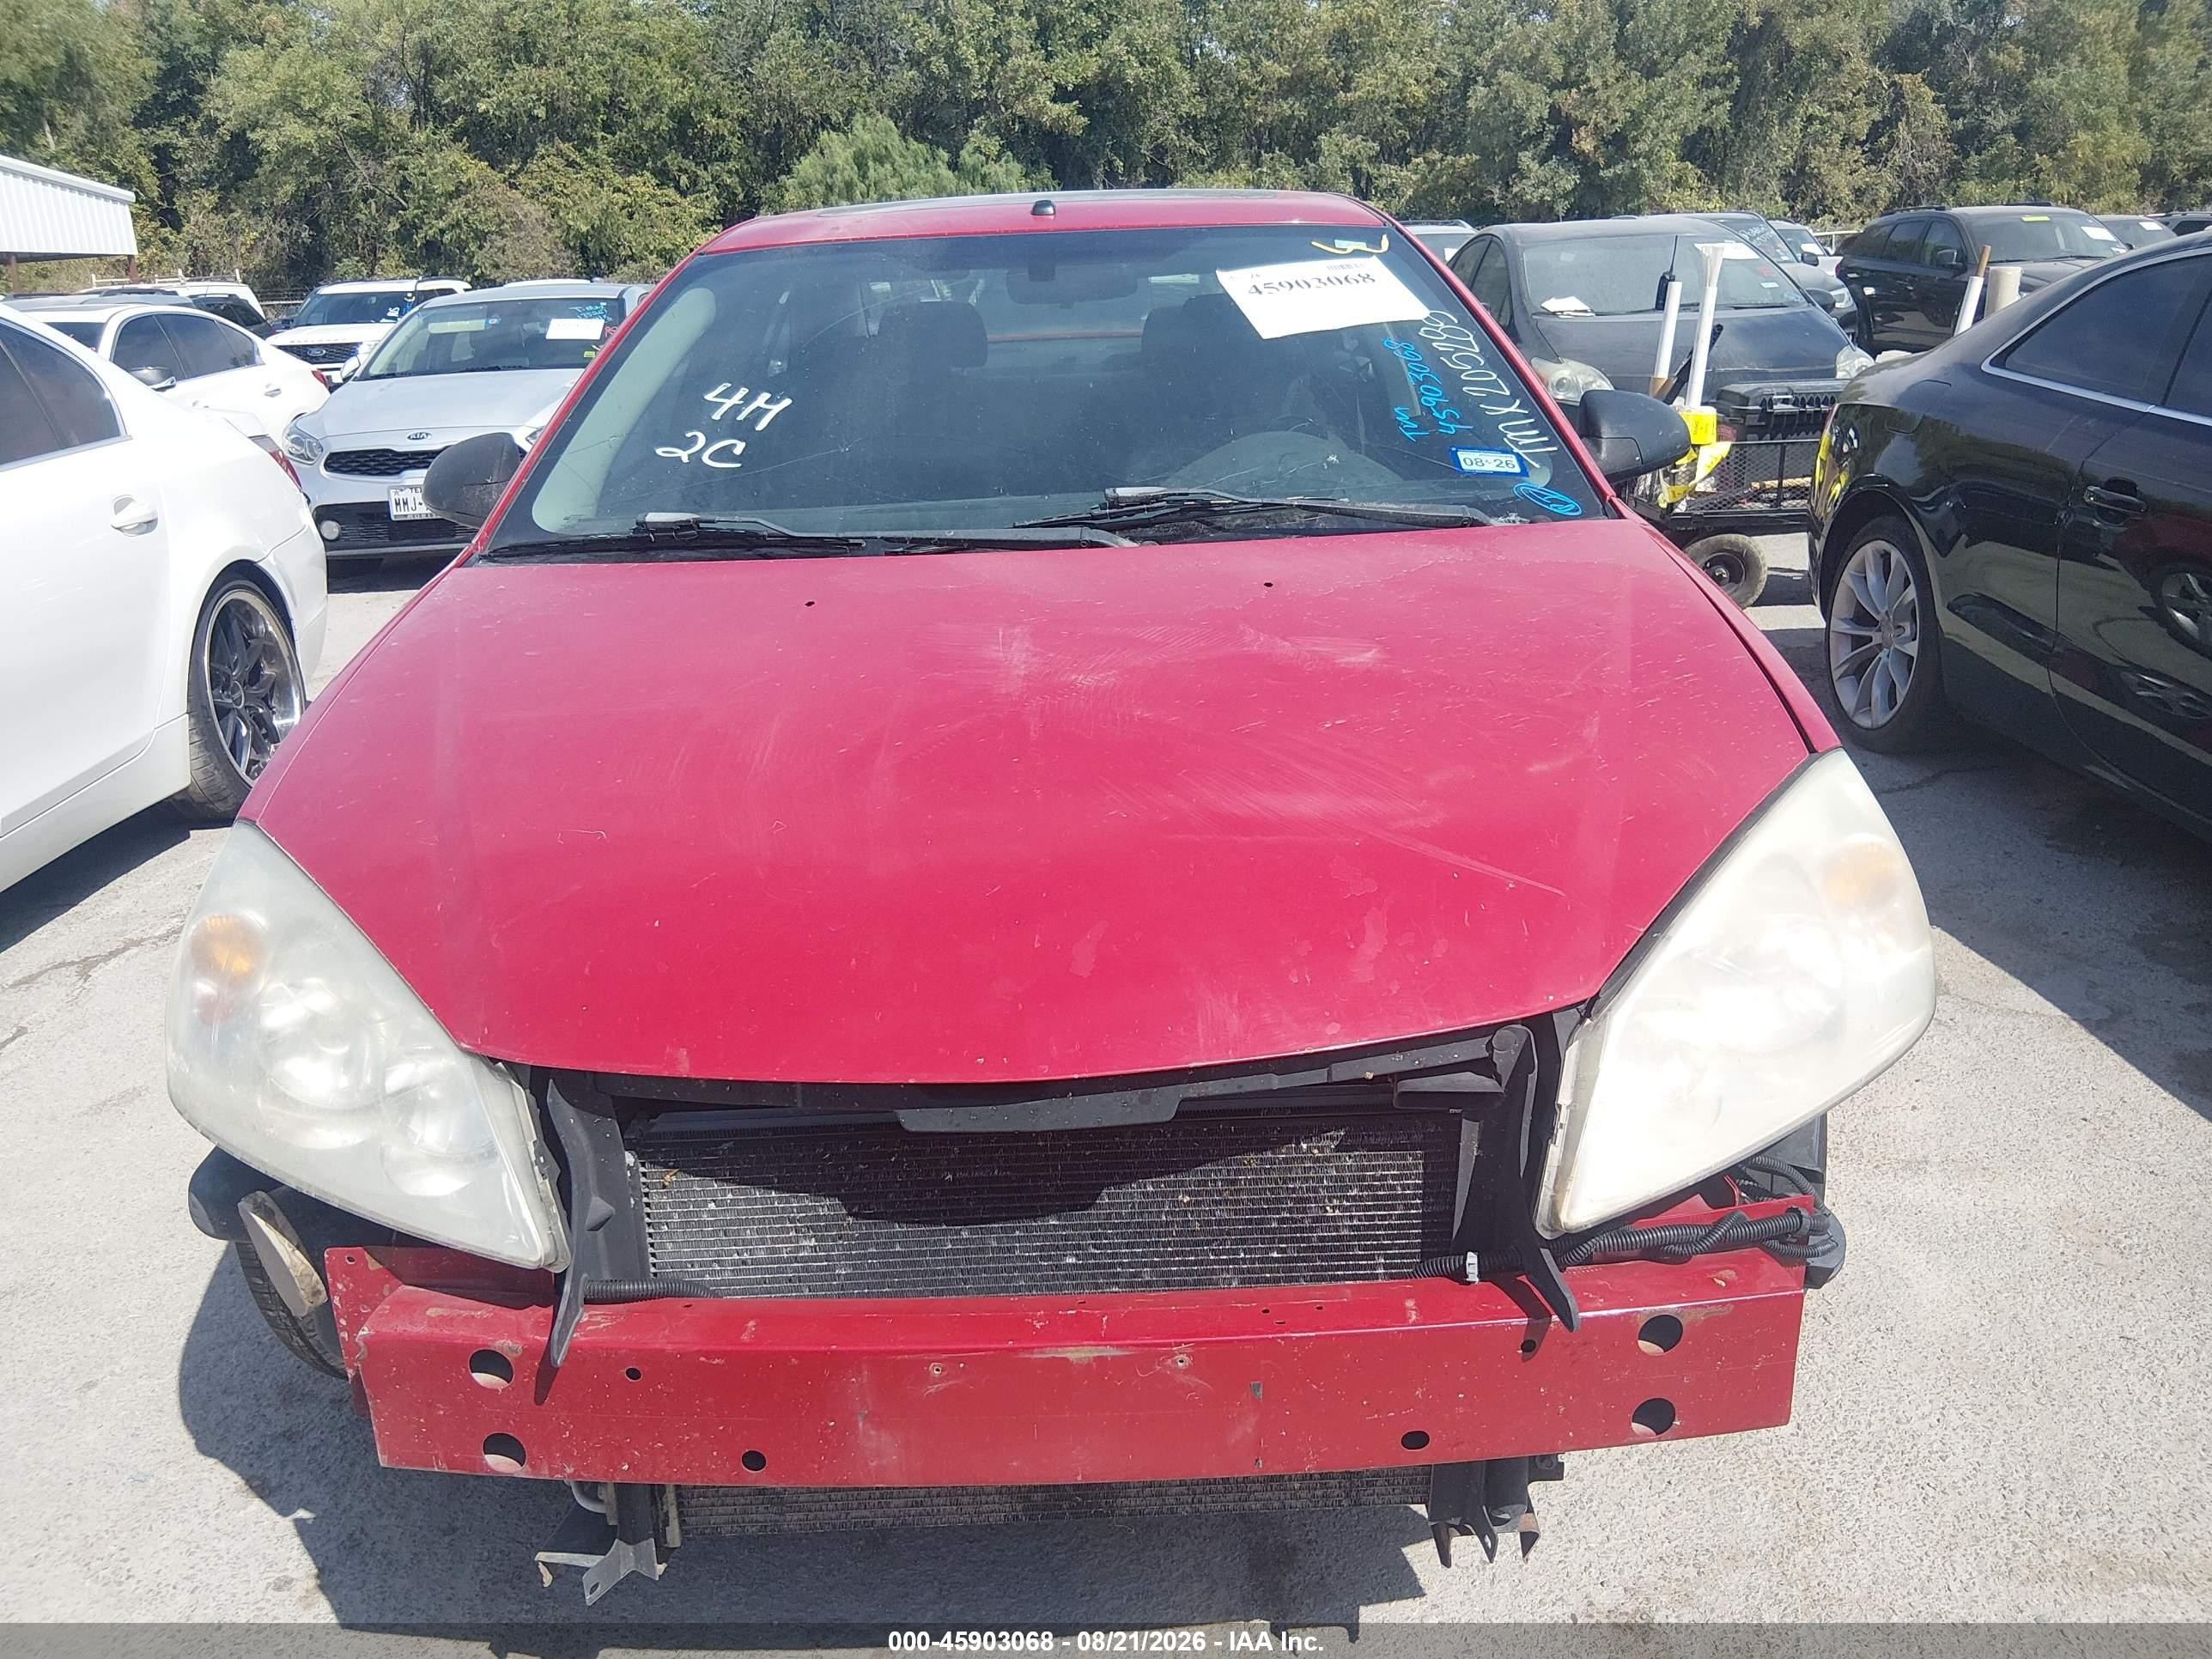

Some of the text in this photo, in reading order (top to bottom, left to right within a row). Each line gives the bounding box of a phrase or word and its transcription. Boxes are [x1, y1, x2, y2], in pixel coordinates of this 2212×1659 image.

[1249, 272, 1376, 295] 45903068
[1382, 337, 1474, 434] 45903068
[1462, 456, 1485, 468] 08
[1493, 459, 1516, 470] 26
